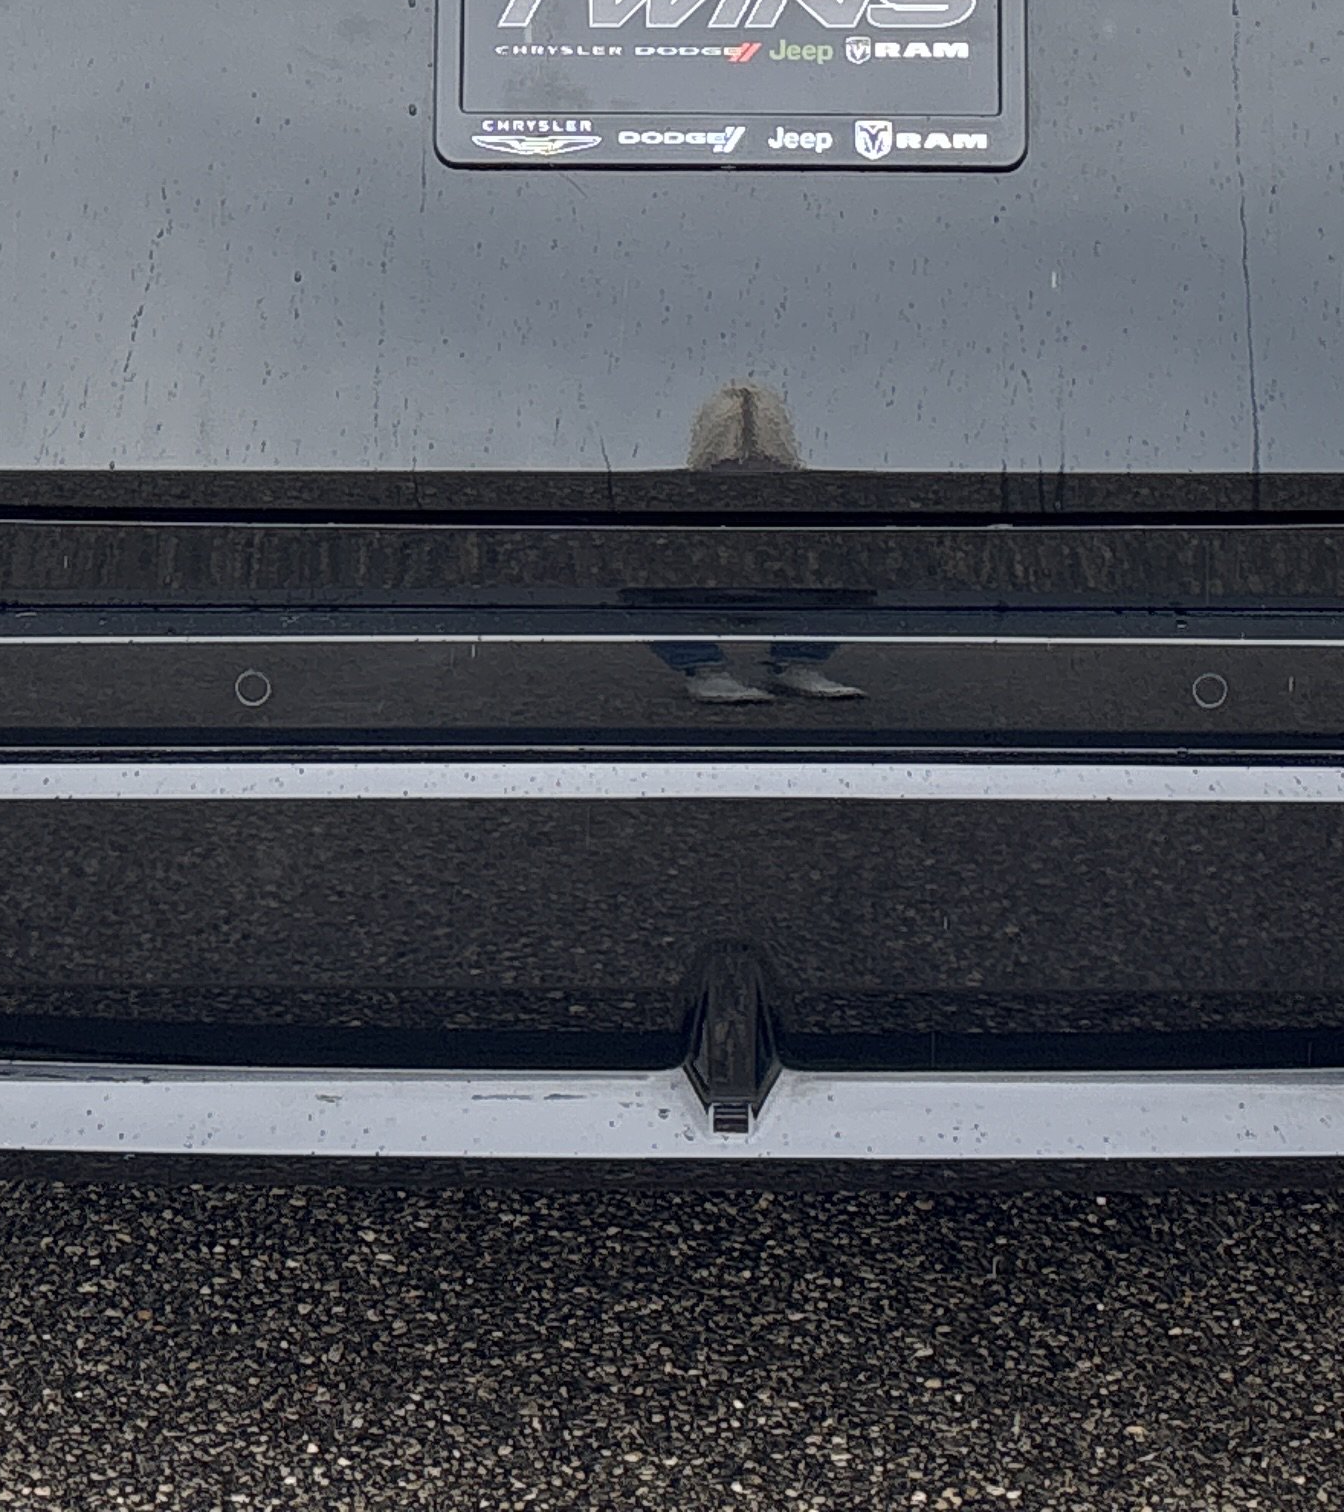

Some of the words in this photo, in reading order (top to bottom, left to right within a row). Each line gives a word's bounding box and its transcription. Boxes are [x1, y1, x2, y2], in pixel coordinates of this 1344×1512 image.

[494, 45, 623, 57] CHRYSLER
[634, 45, 742, 57] DODGE
[769, 39, 834, 65] Jeep
[874, 41, 970, 59] RAM
[481, 119, 593, 133] CHRYSLER
[617, 130, 728, 145] DODGE
[767, 126, 834, 154] Jeep
[895, 132, 989, 150] RAM
